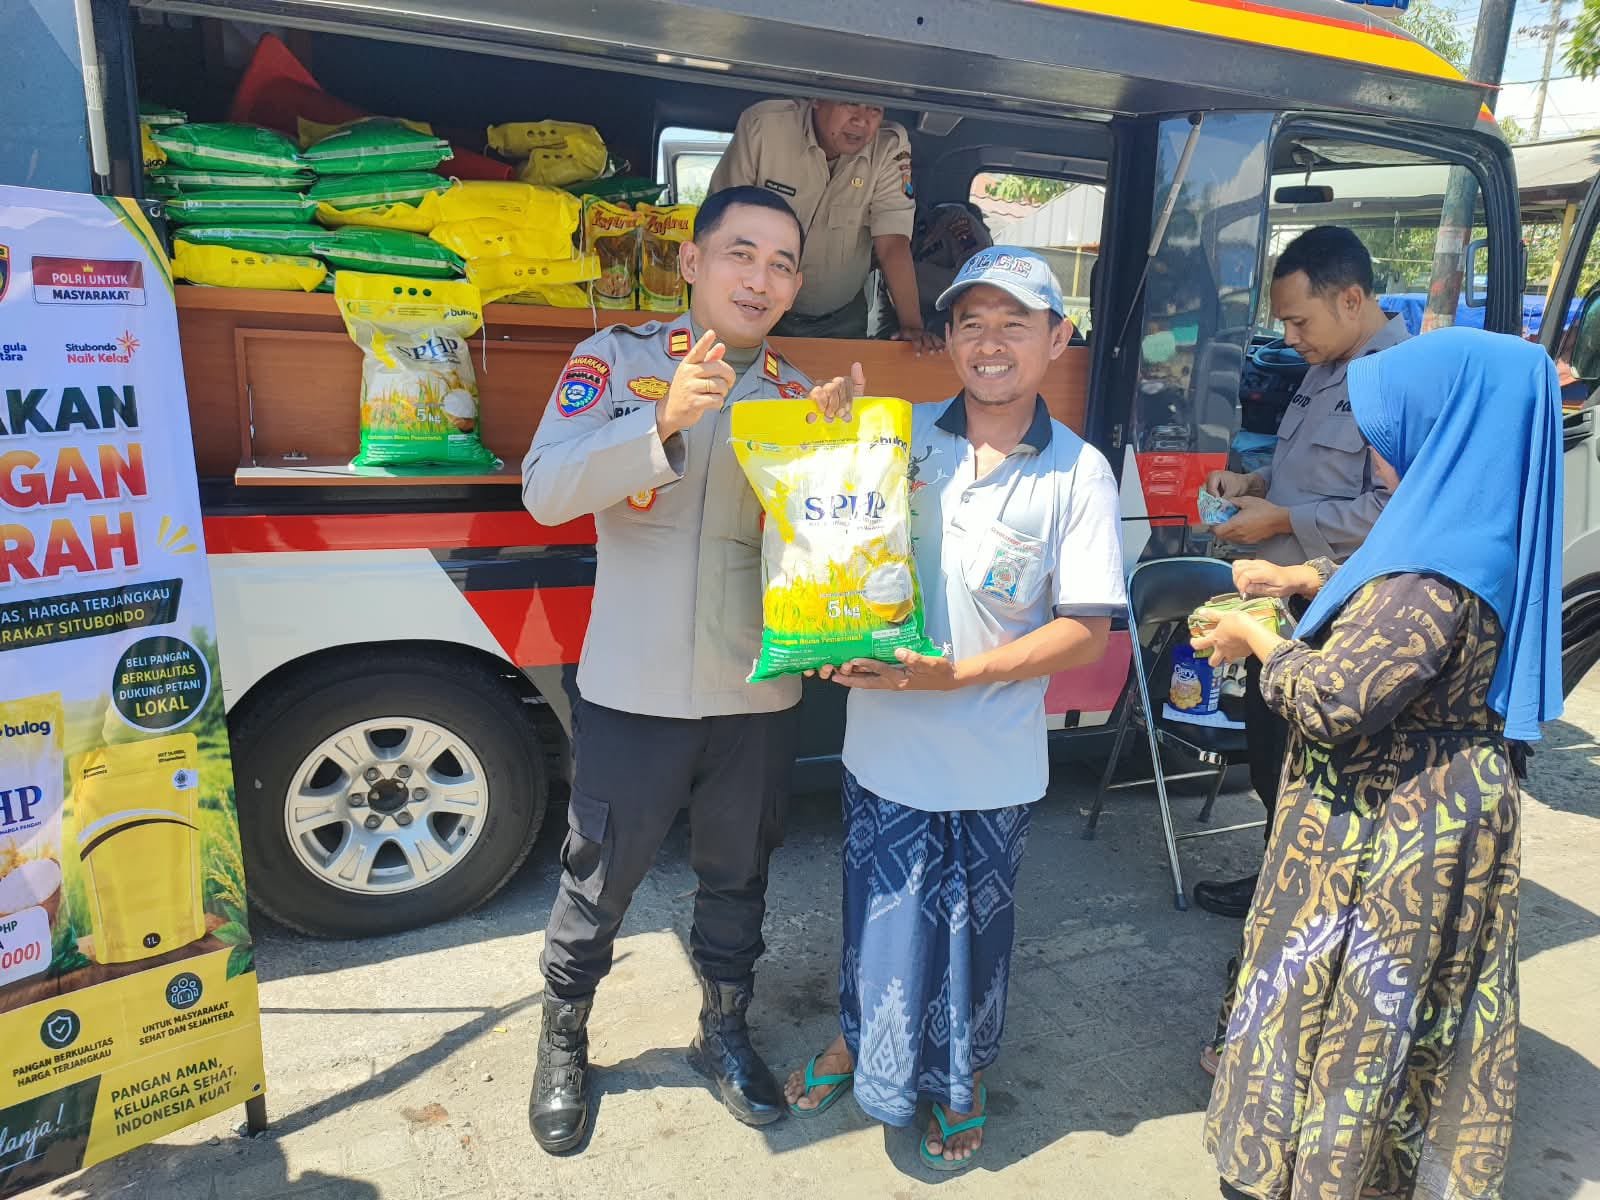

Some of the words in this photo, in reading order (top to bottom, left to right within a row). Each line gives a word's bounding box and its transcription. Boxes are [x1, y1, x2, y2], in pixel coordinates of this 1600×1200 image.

[52, 273, 86, 285] POLRI
[88, 273, 129, 286] UNTUK
[52, 289, 131, 302] MASYARAKAT
[3, 342, 28, 354] gula
[66, 342, 118, 352] Situbondo
[67, 354, 97, 364] Naik
[98, 353, 130, 364] Kelas
[0, 385, 139, 436] KAN
[415, 407, 425, 423] 5
[0, 442, 147, 508] GAN
[0, 511, 139, 583] RAH
[1, 609, 26, 624] AS,
[29, 602, 80, 620] HARGA
[83, 587, 170, 612] TERJANGKAU
[828, 600, 841, 619] 5
[0, 623, 54, 644] RAKAT
[59, 608, 145, 635] SITUBONDO
[126, 655, 148, 668] BELI
[150, 650, 190, 666] PANGAN
[121, 664, 196, 685] BERKUALITAS
[119, 684, 164, 700] DUKUNG
[165, 679, 201, 694] PETANI
[135, 695, 190, 718] LOKAL
[4, 720, 51, 738] bulog
[139, 1031, 166, 1046] SEHAT
[167, 1024, 187, 1038] DAN
[188, 1011, 235, 1032] SEJAHTERA
[142, 1018, 173, 1034] UNTUK
[173, 1002, 229, 1026] MASYARAKAT
[12, 1058, 53, 1077] PANGAN
[53, 1038, 114, 1068] BERKUALITAS
[17, 1070, 52, 1088] HARGA
[52, 1050, 112, 1075] TERJANGKAU
[111, 1076, 173, 1103] PANGAN
[175, 1057, 222, 1081] AMAN,
[113, 1087, 190, 1121] KELUARGA
[193, 1066, 237, 1089] SEHAT,
[116, 1100, 195, 1137] INDONESIA
[199, 1081, 233, 1105] KUAT
